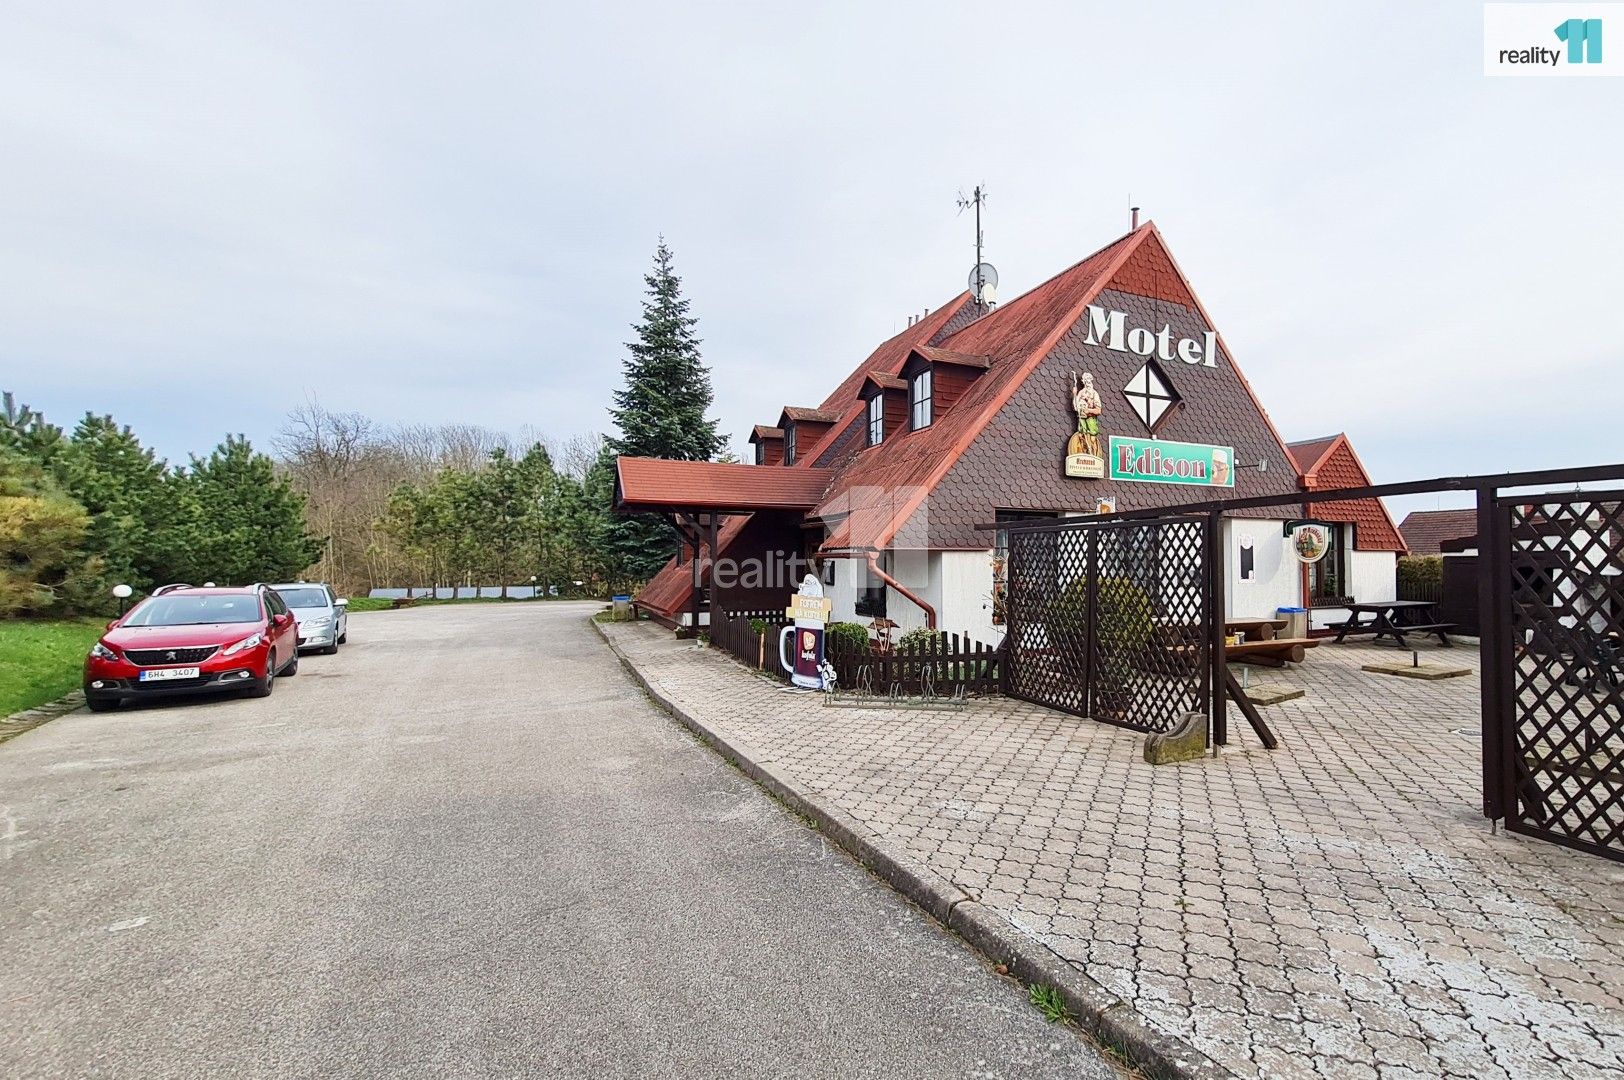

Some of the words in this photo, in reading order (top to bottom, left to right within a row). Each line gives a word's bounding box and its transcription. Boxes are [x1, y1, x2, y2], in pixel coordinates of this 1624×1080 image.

[1083, 305, 1218, 368] Motel
[1116, 444, 1207, 480] Edison
[172, 668, 195, 677] 3407
